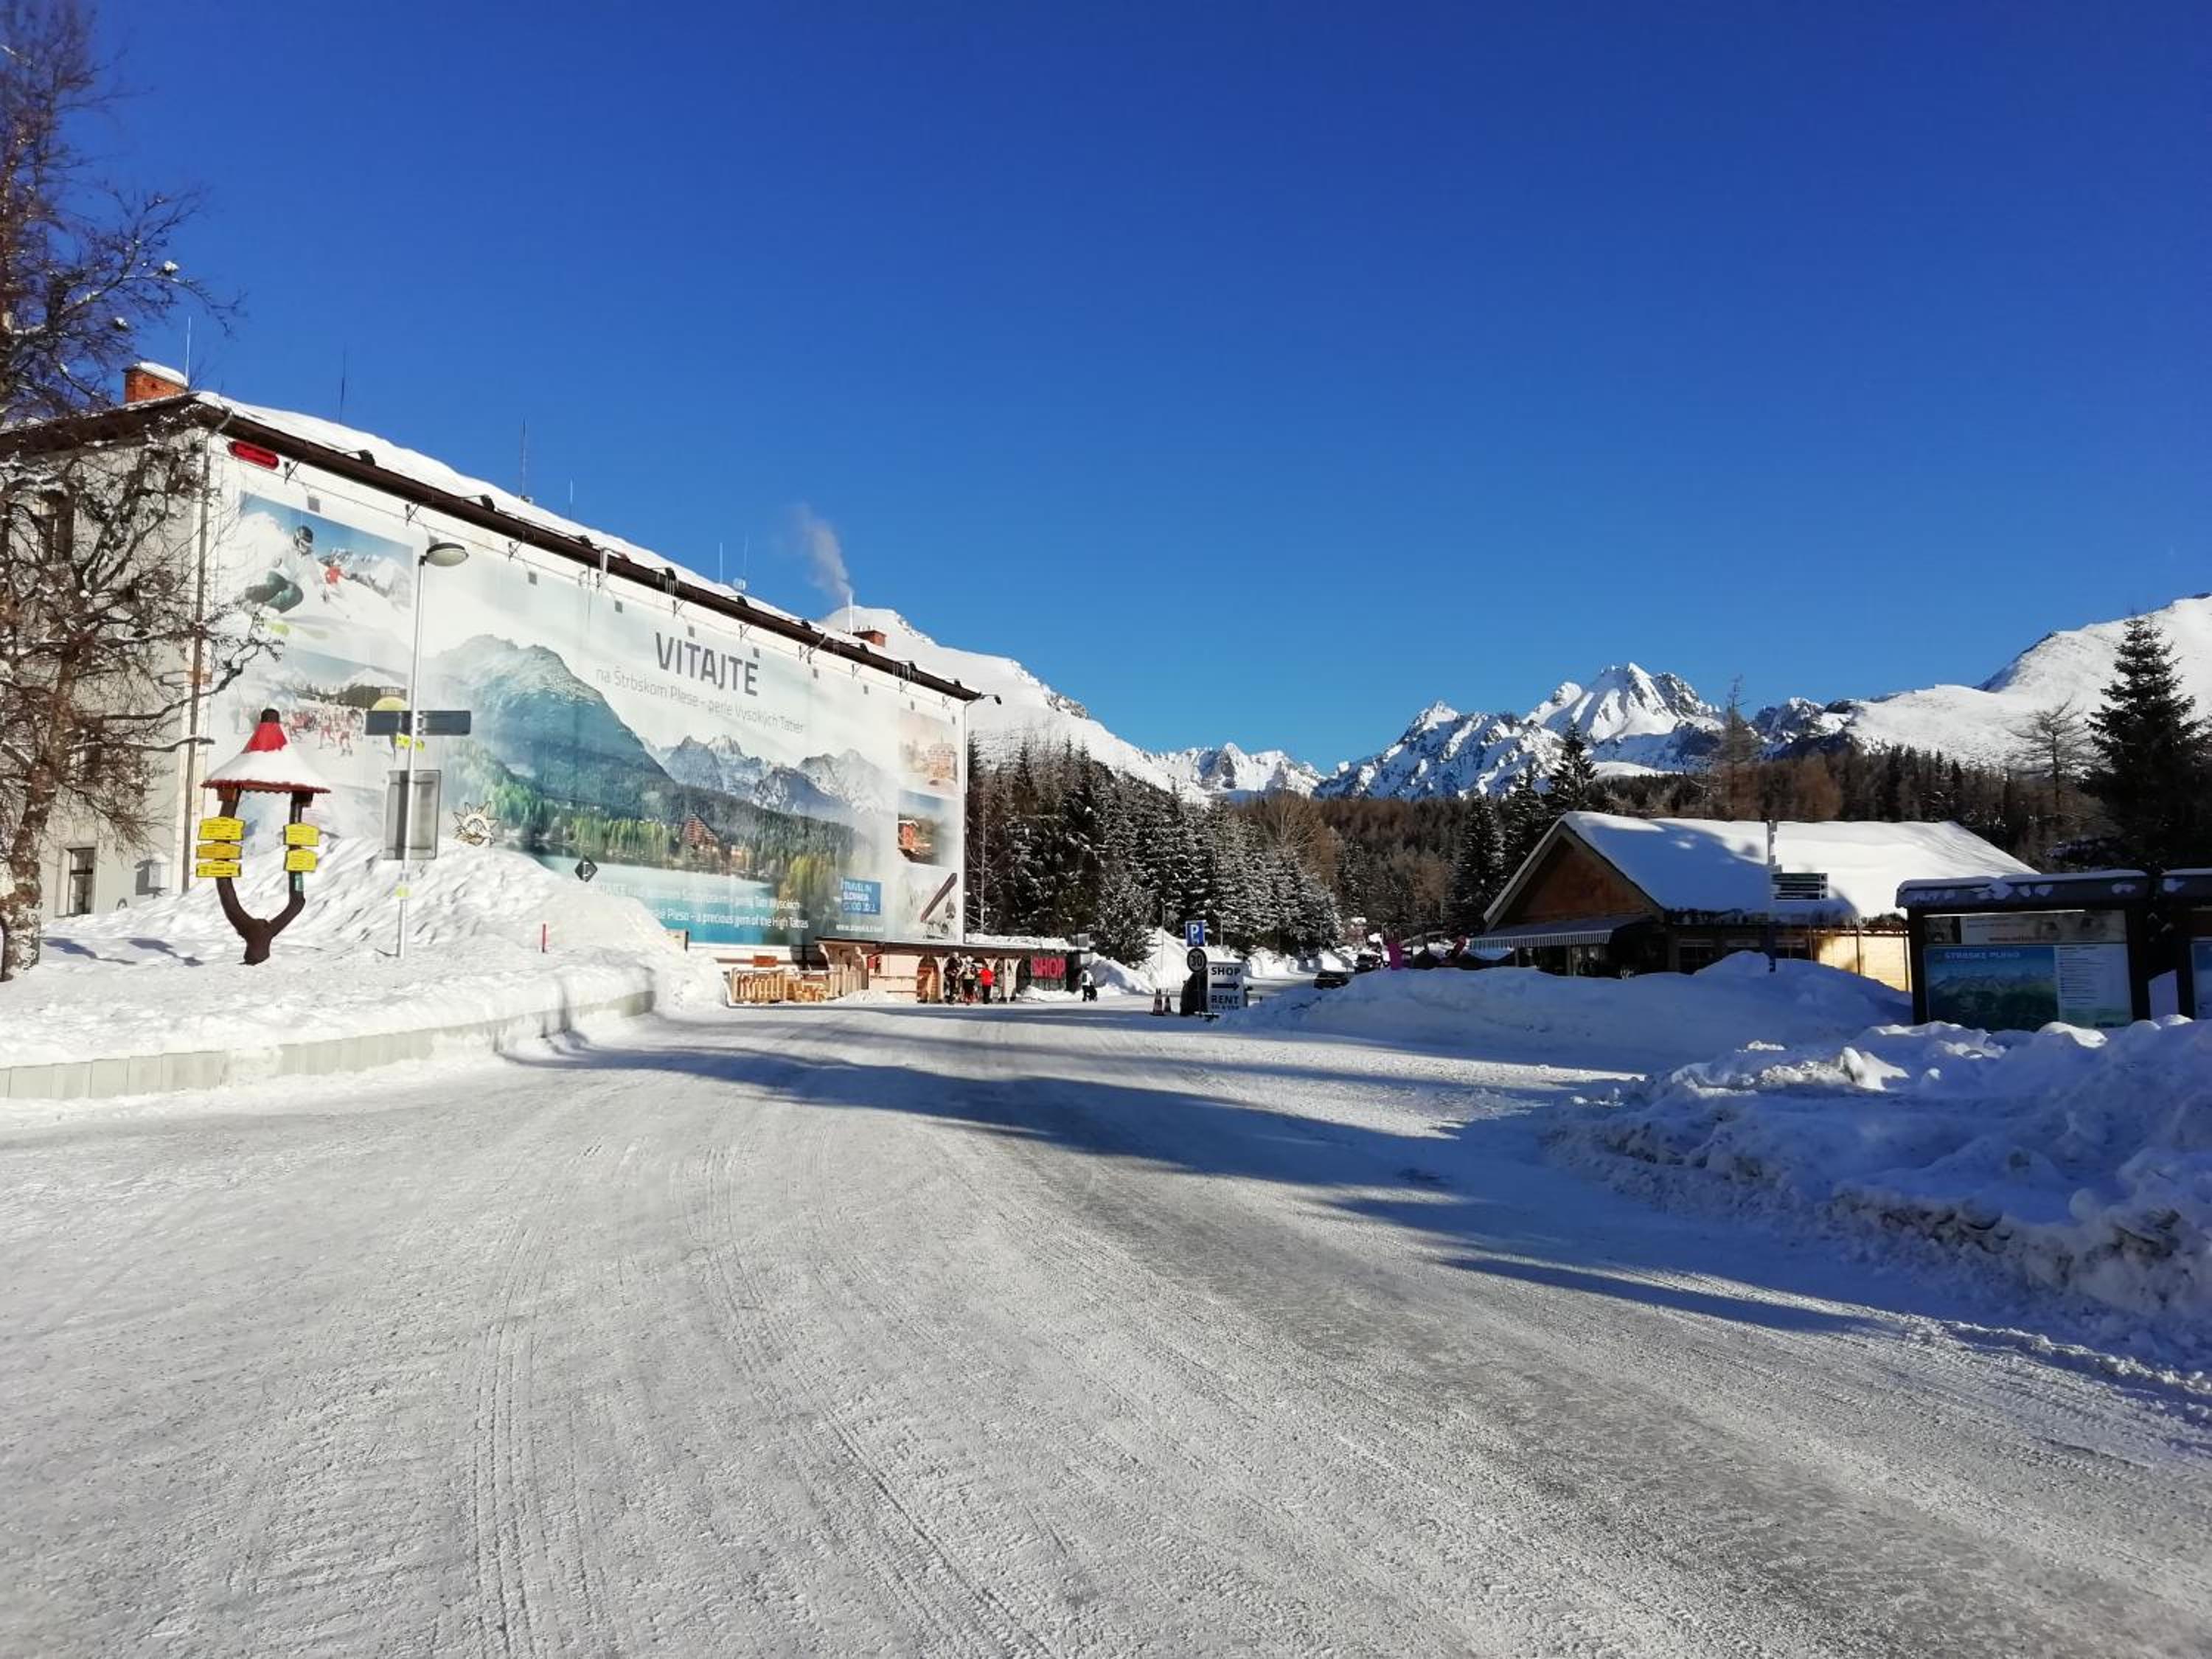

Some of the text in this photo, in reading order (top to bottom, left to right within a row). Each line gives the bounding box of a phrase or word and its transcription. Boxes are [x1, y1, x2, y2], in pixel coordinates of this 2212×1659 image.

[655, 632, 759, 697] VITAJTE
[596, 668, 611, 684] na
[670, 686, 699, 707] Plese
[1190, 924, 1200, 939] P
[1034, 957, 1066, 978] SHOP
[1190, 955, 1203, 967] 30
[1211, 967, 1241, 975] SHOP
[1211, 995, 1239, 1004] RENT
